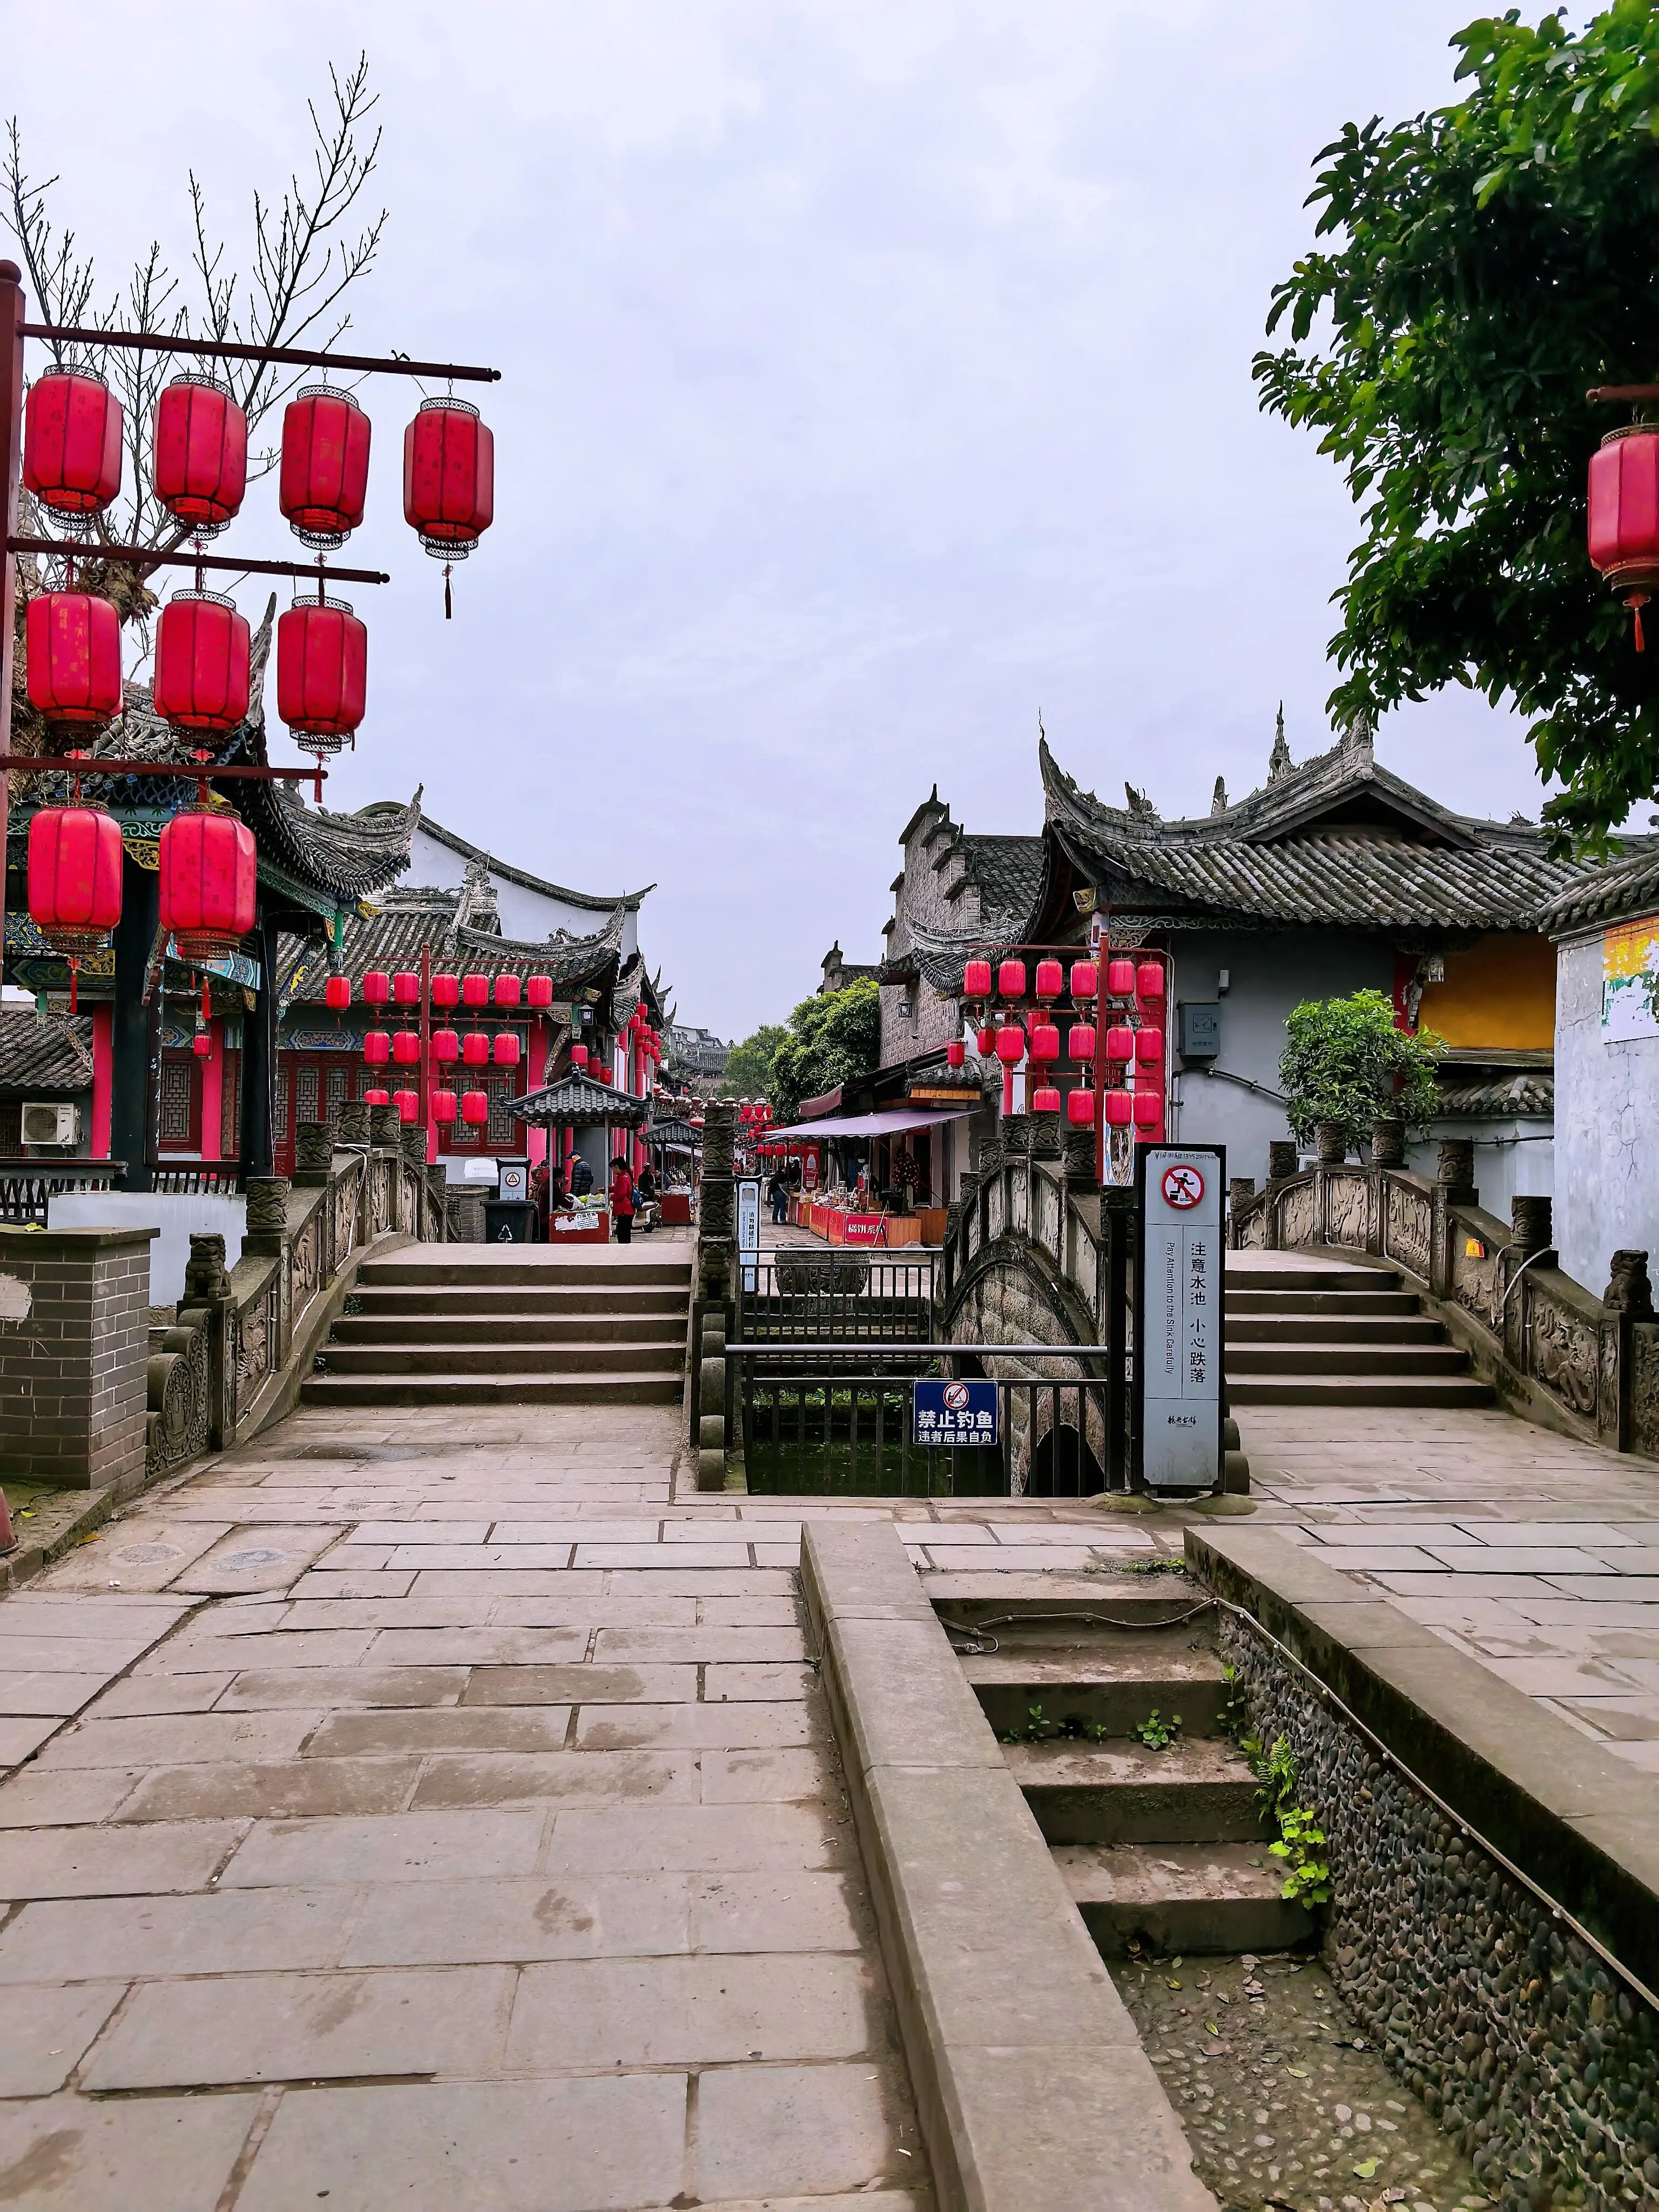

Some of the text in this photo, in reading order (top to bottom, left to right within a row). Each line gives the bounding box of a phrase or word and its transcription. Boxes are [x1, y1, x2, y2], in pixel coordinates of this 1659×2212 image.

[1165, 1242, 1175, 1256] Pay
[1166, 1257, 1175, 1293] Attention
[1166, 1305, 1175, 1317] the
[1190, 1242, 1206, 1383] 注意水池 小心跌落
[1166, 1319, 1175, 1337] Sink
[1165, 1339, 1174, 1374] Carefully
[918, 1410, 993, 1429] 禁止钓鱼
[918, 1430, 992, 1443] 违者后果自负
